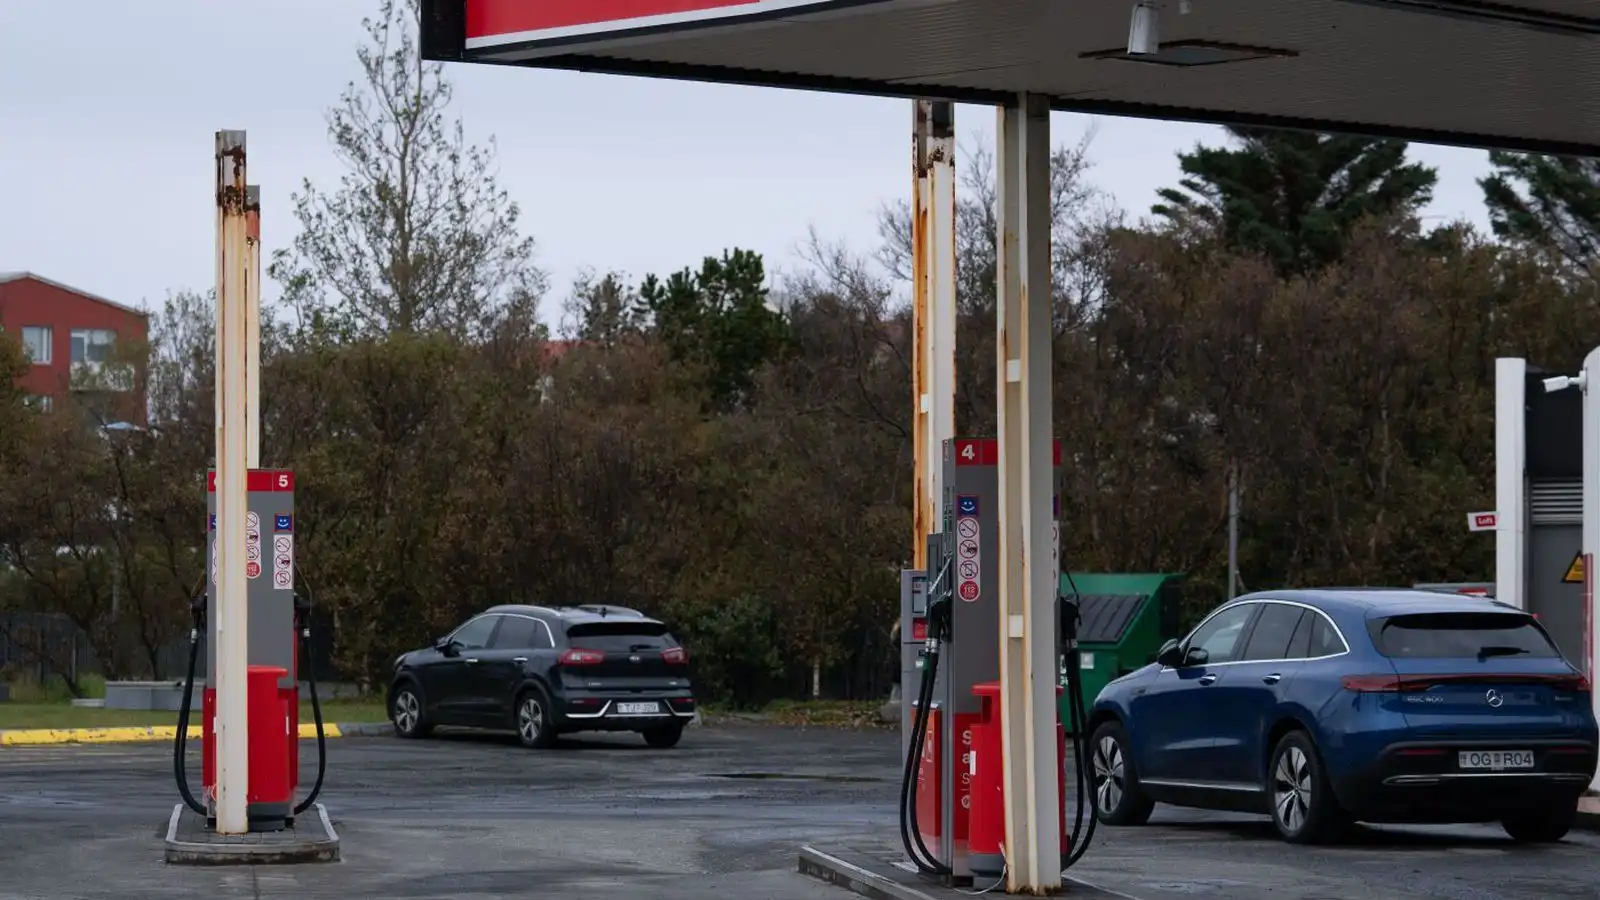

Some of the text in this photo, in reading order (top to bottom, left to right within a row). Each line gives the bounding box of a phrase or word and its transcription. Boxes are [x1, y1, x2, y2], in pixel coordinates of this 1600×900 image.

[961, 444, 975, 460] 4
[278, 474, 289, 488] 5
[1470, 752, 1492, 766] OG
